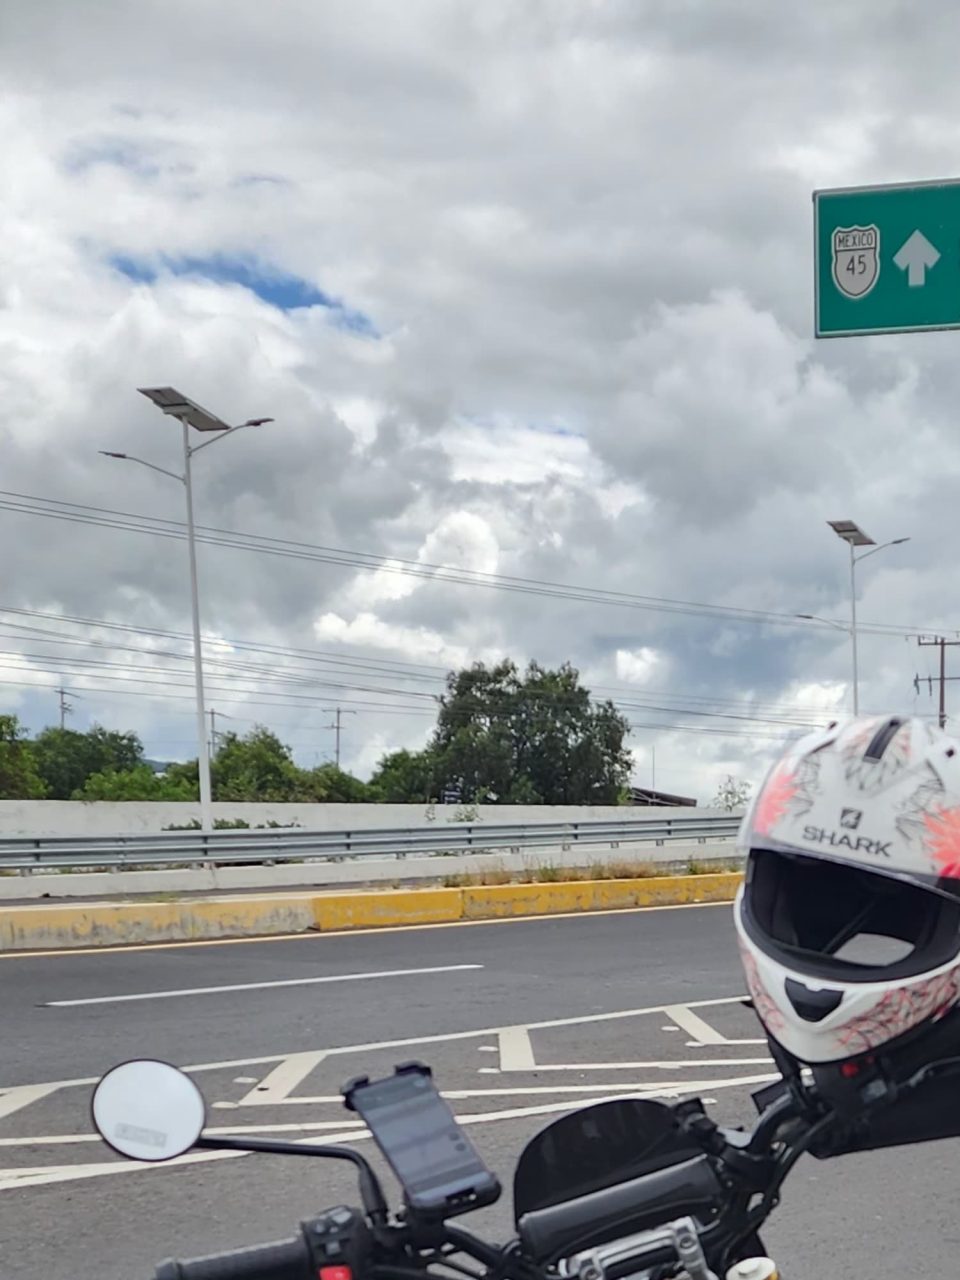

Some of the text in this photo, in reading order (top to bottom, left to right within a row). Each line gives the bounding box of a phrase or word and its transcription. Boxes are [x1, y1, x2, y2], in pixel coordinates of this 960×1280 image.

[837, 232, 875, 249] MEXICO
[846, 253, 867, 275] 45
[802, 825, 893, 858] SHARK
